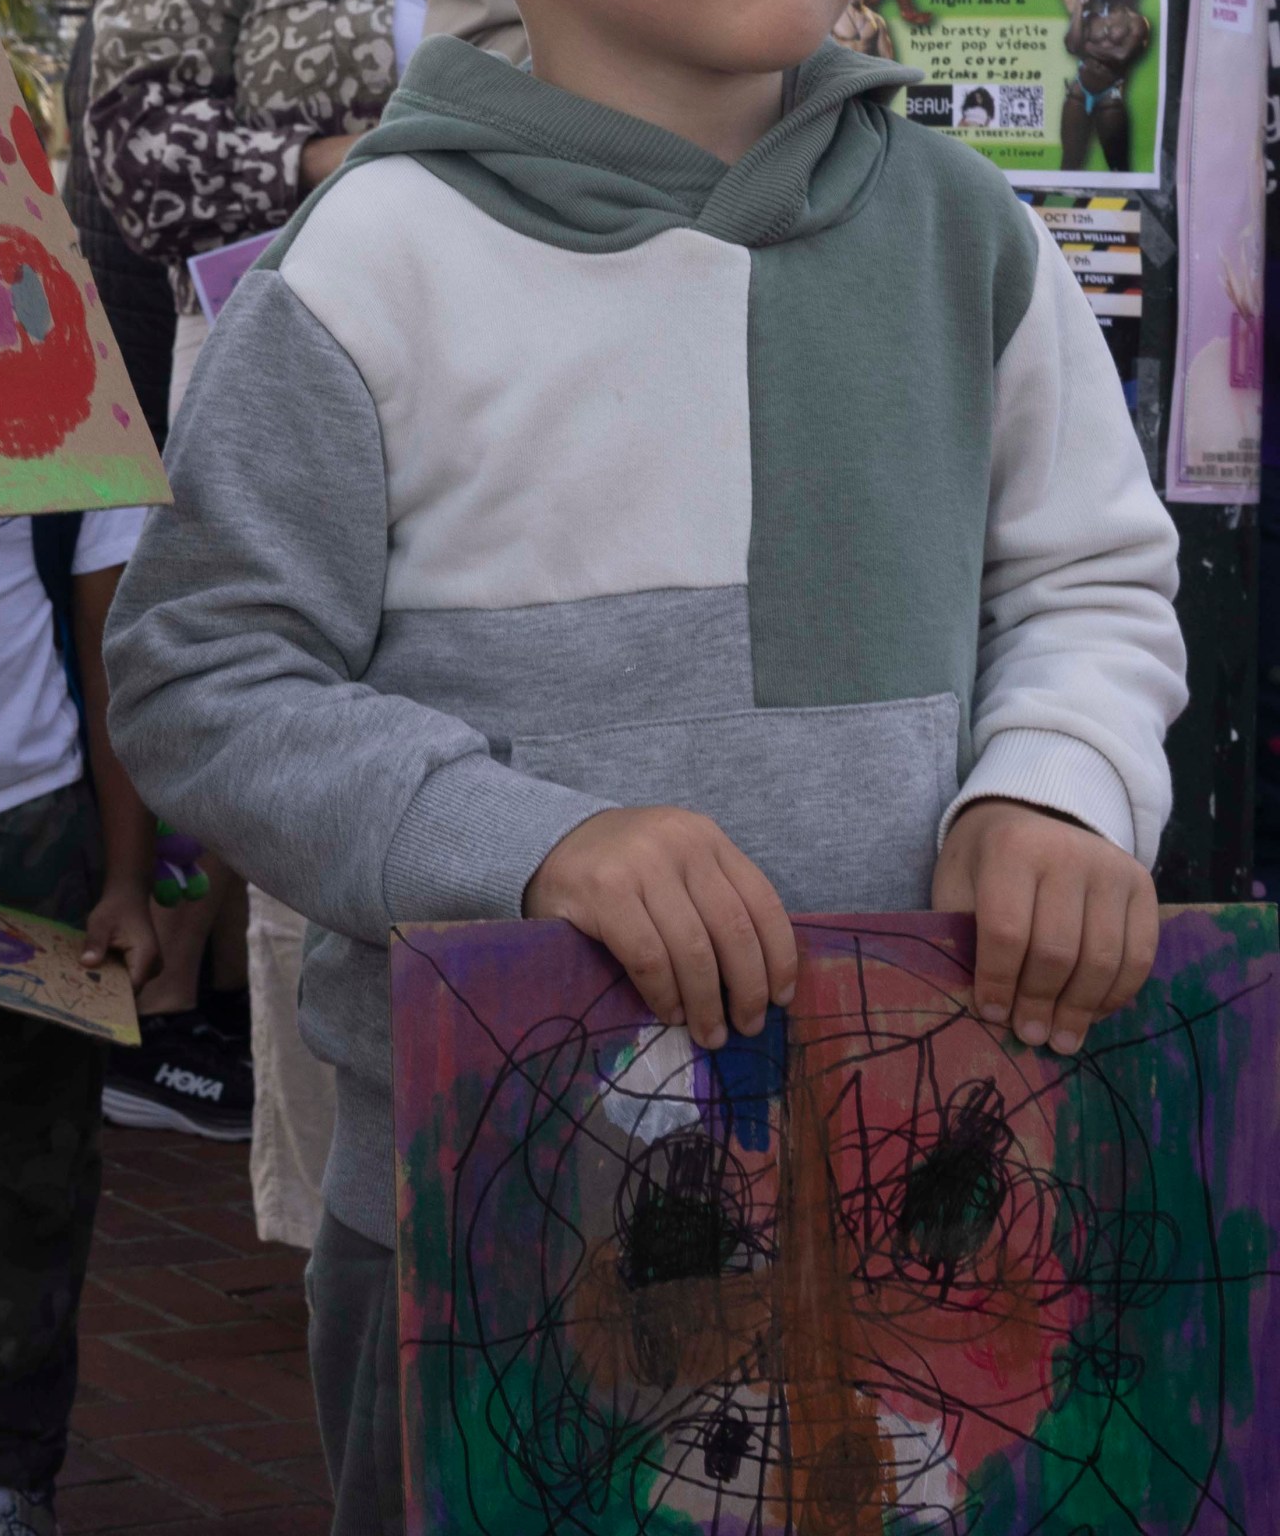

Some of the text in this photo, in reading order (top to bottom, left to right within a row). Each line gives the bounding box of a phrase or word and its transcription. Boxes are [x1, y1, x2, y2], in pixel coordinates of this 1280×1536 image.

[941, 25, 991, 39] bratty
[999, 25, 1048, 39] girlie
[910, 38, 1047, 52] hyper pop videos
[931, 55, 1018, 66] no cover
[931, 69, 1042, 80] drinks 9-10:30
[1044, 213, 1095, 225] OCT 12th
[1083, 232, 1127, 244] WILLIAMS
[1073, 256, 1091, 265] 9th
[153, 1062, 224, 1102] HOKA
